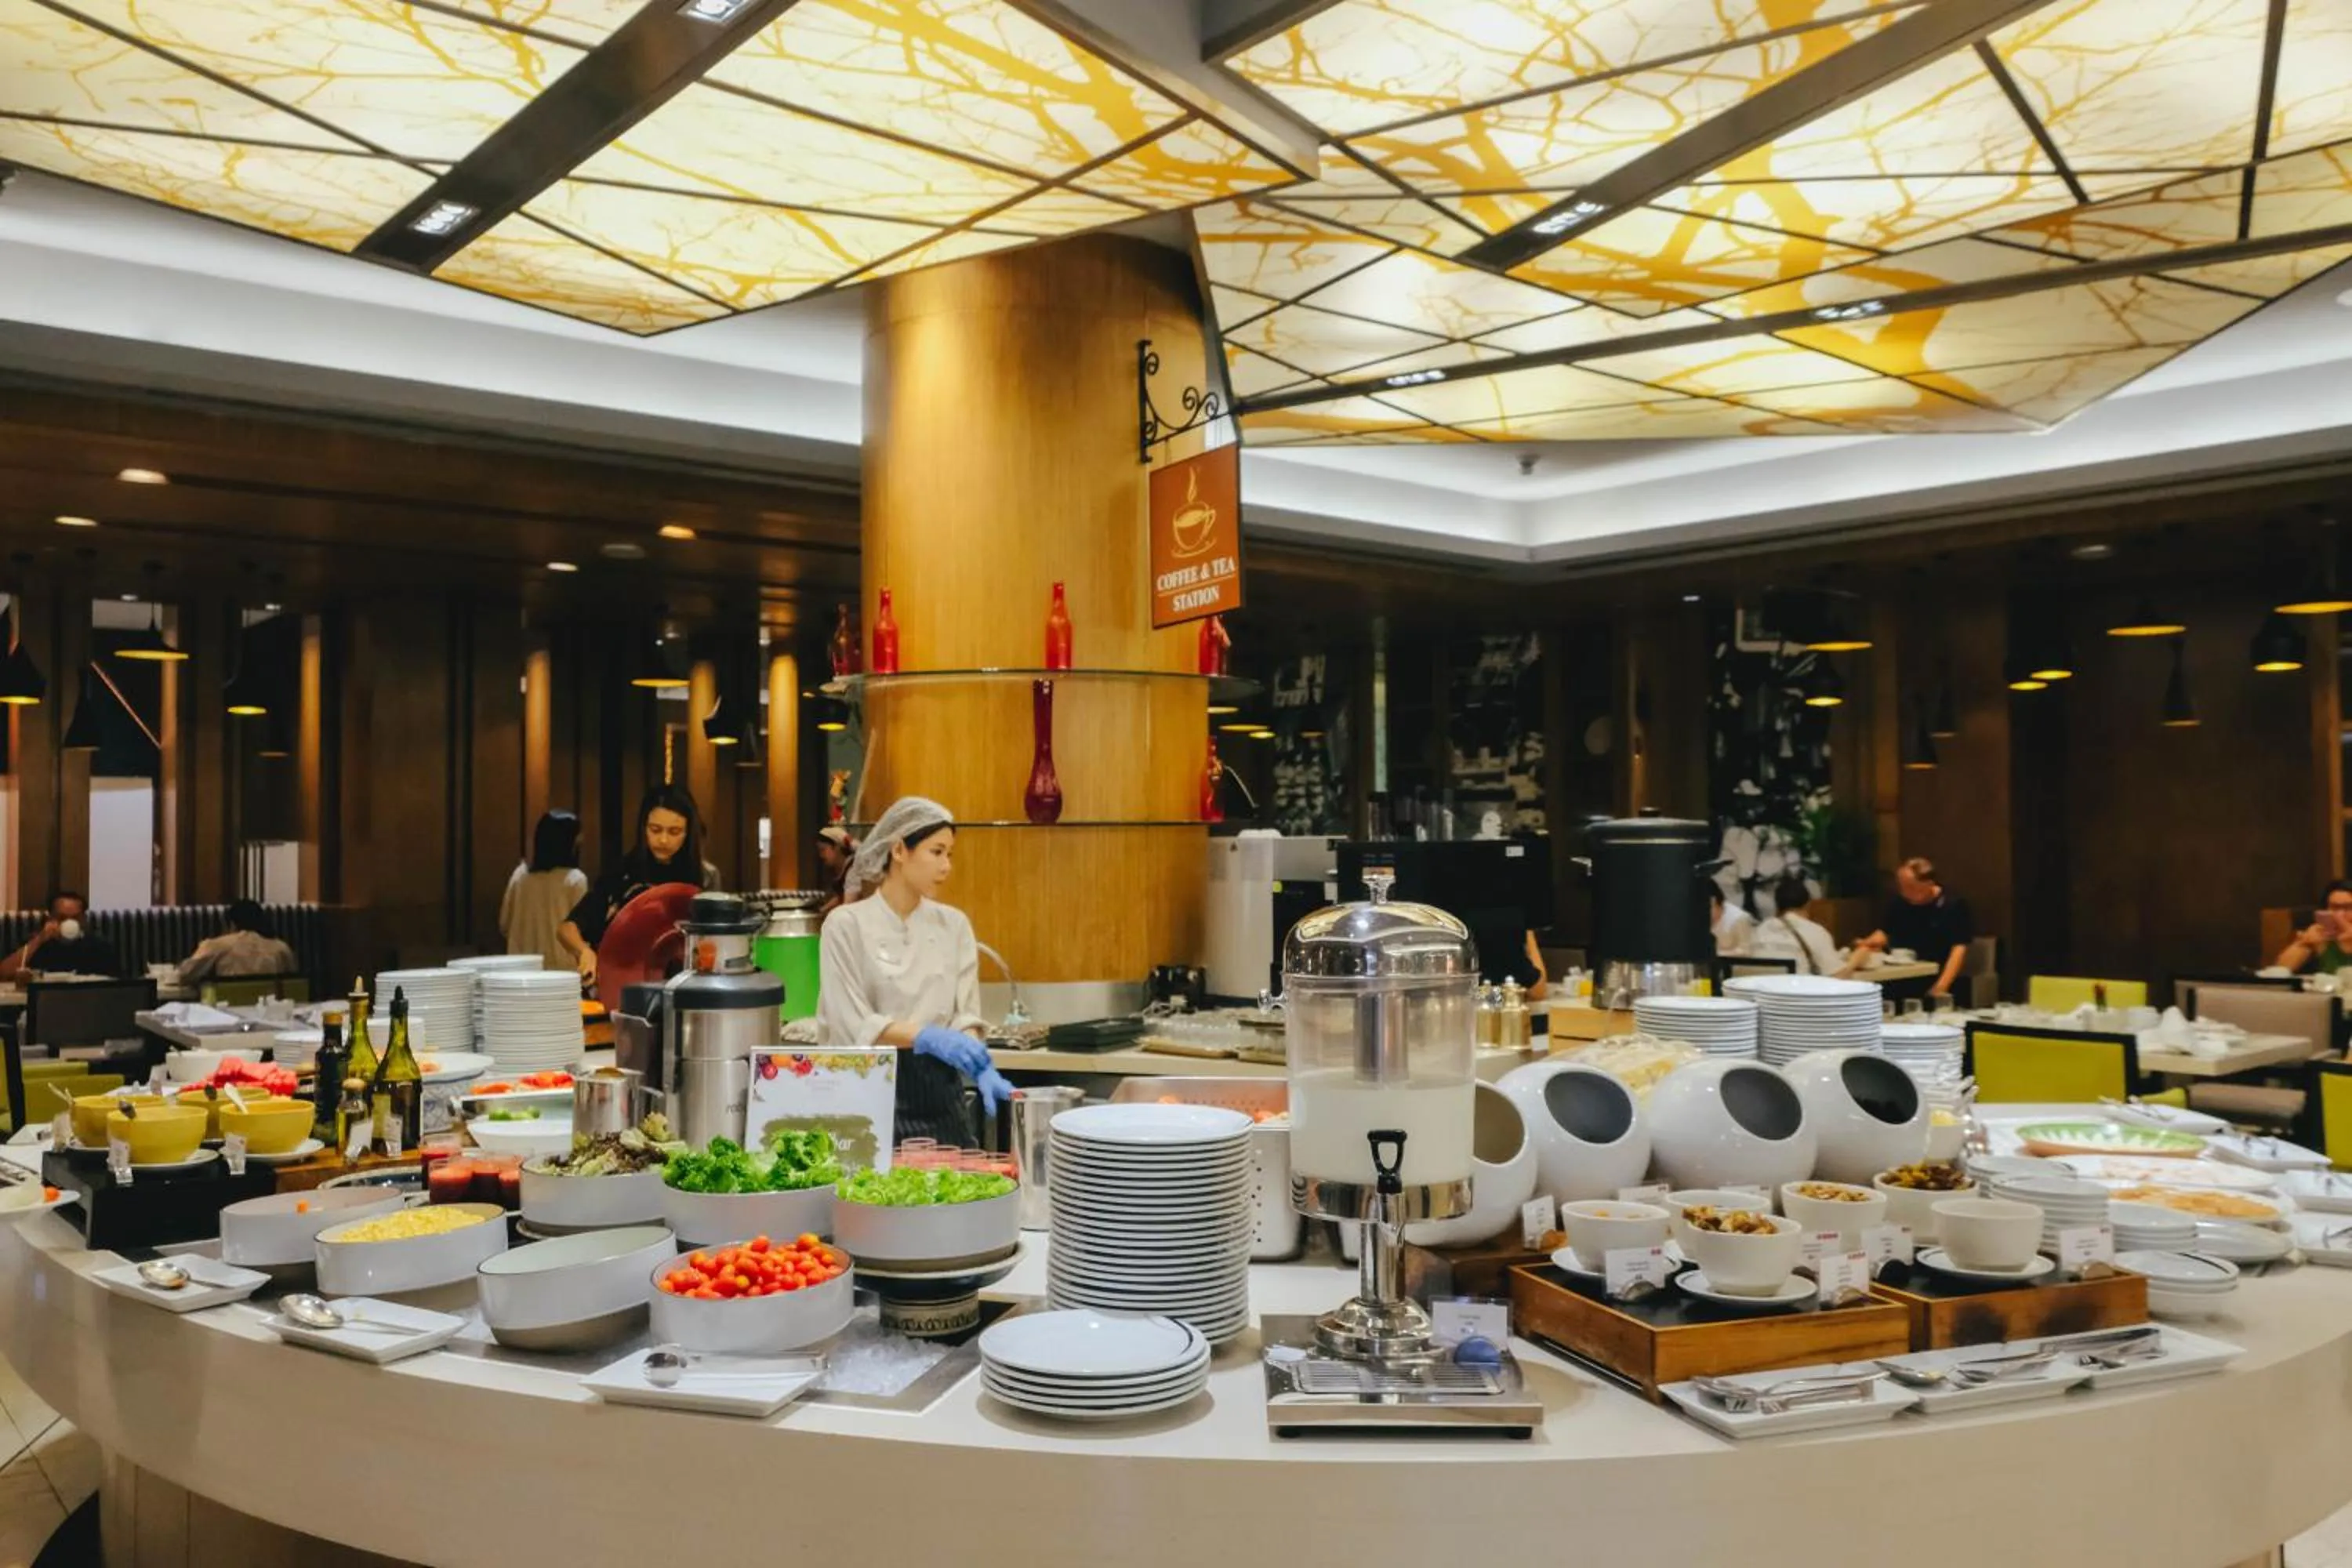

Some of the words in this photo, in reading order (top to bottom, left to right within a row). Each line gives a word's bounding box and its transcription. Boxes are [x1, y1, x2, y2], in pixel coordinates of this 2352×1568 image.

[1157, 566, 1199, 590] COFFEE
[1200, 562, 1210, 579] &
[1211, 556, 1236, 576] TEA
[1173, 585, 1220, 612] STATION
